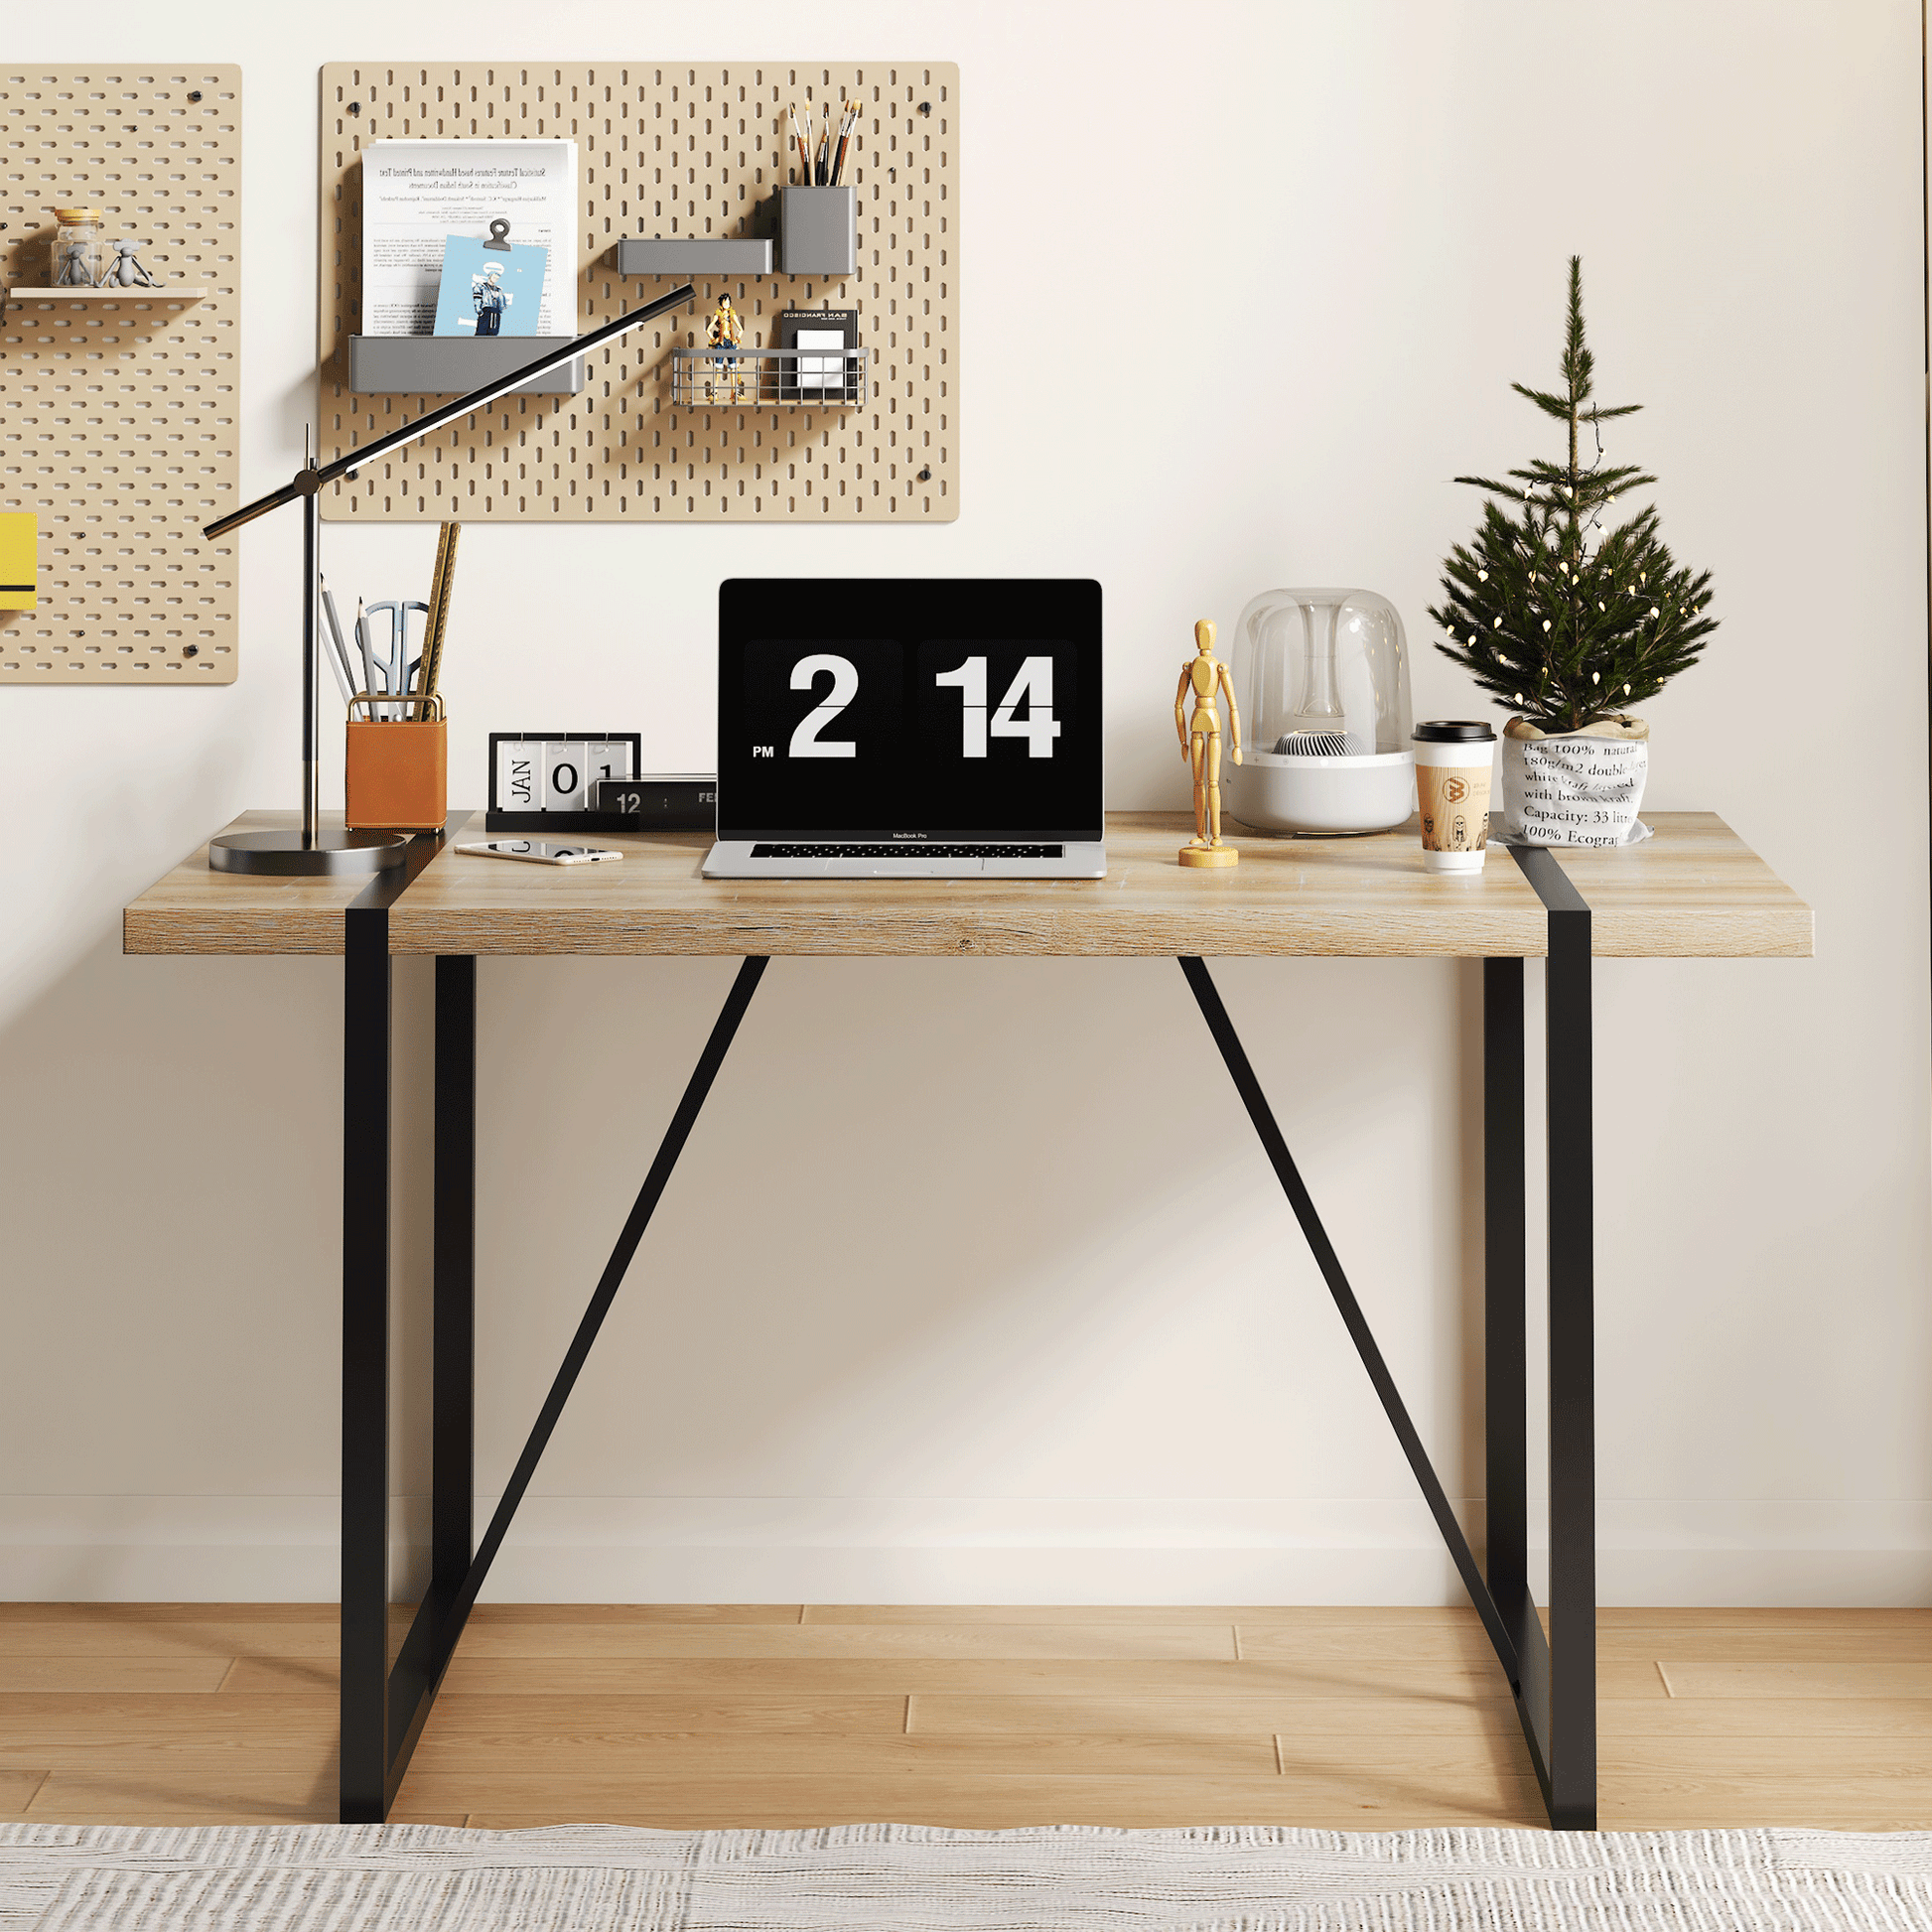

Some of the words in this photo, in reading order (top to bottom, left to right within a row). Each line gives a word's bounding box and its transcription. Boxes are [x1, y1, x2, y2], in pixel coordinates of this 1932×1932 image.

[753, 746, 774, 758] PM
[788, 653, 859, 758] 2
[936, 656, 1061, 758] 14
[1523, 743, 1548, 754] Bag
[1555, 745, 1595, 756] 100%
[1603, 741, 1637, 756] natural
[1524, 757, 1584, 773] 180g/m2
[511, 759, 531, 803] JAN
[617, 792, 641, 814] 12
[699, 792, 717, 803] FE
[1524, 789, 1552, 800] with
[1558, 790, 1598, 803] brown
[1524, 805, 1588, 825] Capacity:
[1592, 810, 1609, 824] 33
[1523, 824, 1562, 842] 100%
